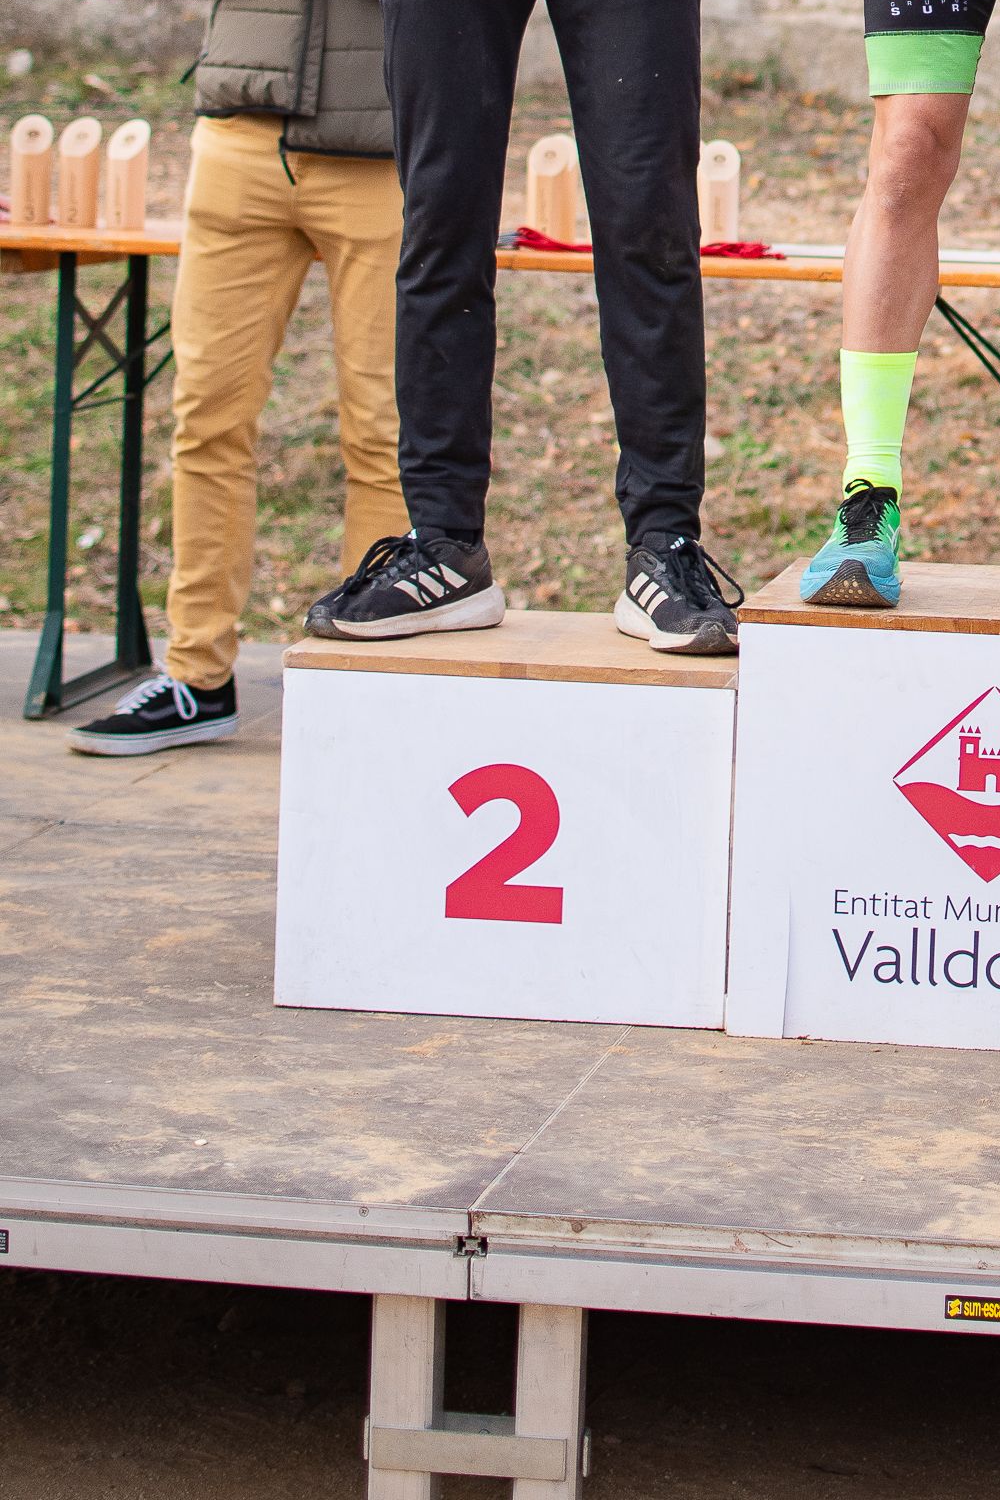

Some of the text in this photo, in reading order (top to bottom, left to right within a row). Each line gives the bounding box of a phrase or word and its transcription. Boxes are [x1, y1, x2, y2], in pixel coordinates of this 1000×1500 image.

[890, 3, 960, 16] SUR
[445, 763, 563, 925] 2
[833, 889, 933, 920] Entitat
